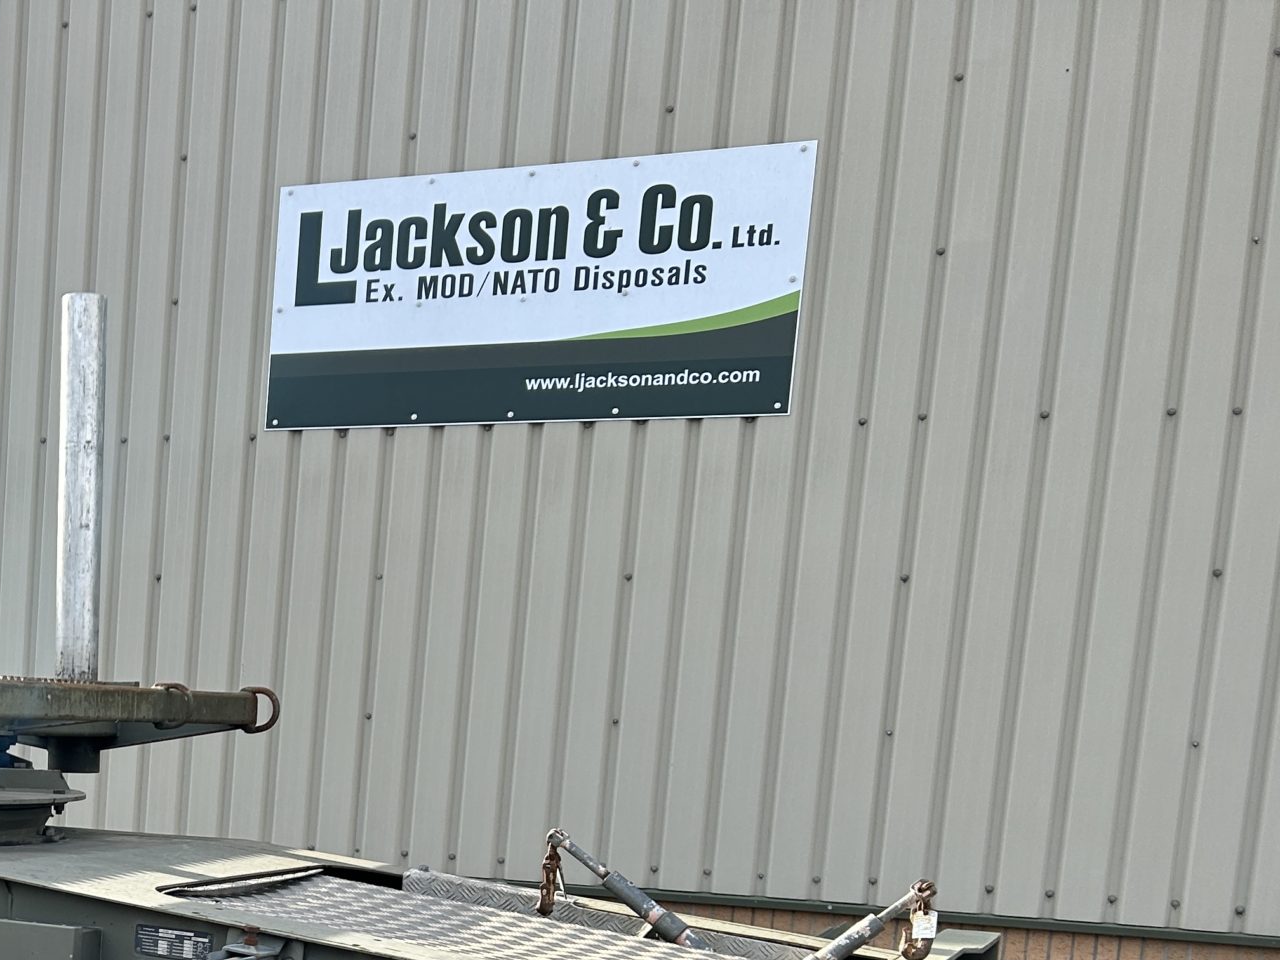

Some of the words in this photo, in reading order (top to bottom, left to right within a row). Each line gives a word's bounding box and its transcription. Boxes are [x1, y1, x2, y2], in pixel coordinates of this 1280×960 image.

[582, 188, 624, 258] &
[638, 183, 723, 255] Co.
[731, 222, 780, 249] Ltd.
[365, 278, 403, 303] Ex.
[416, 267, 561, 300] MOD/NATO
[574, 259, 708, 294] Disposals
[525, 369, 761, 393] www.ljacksonandco.com
